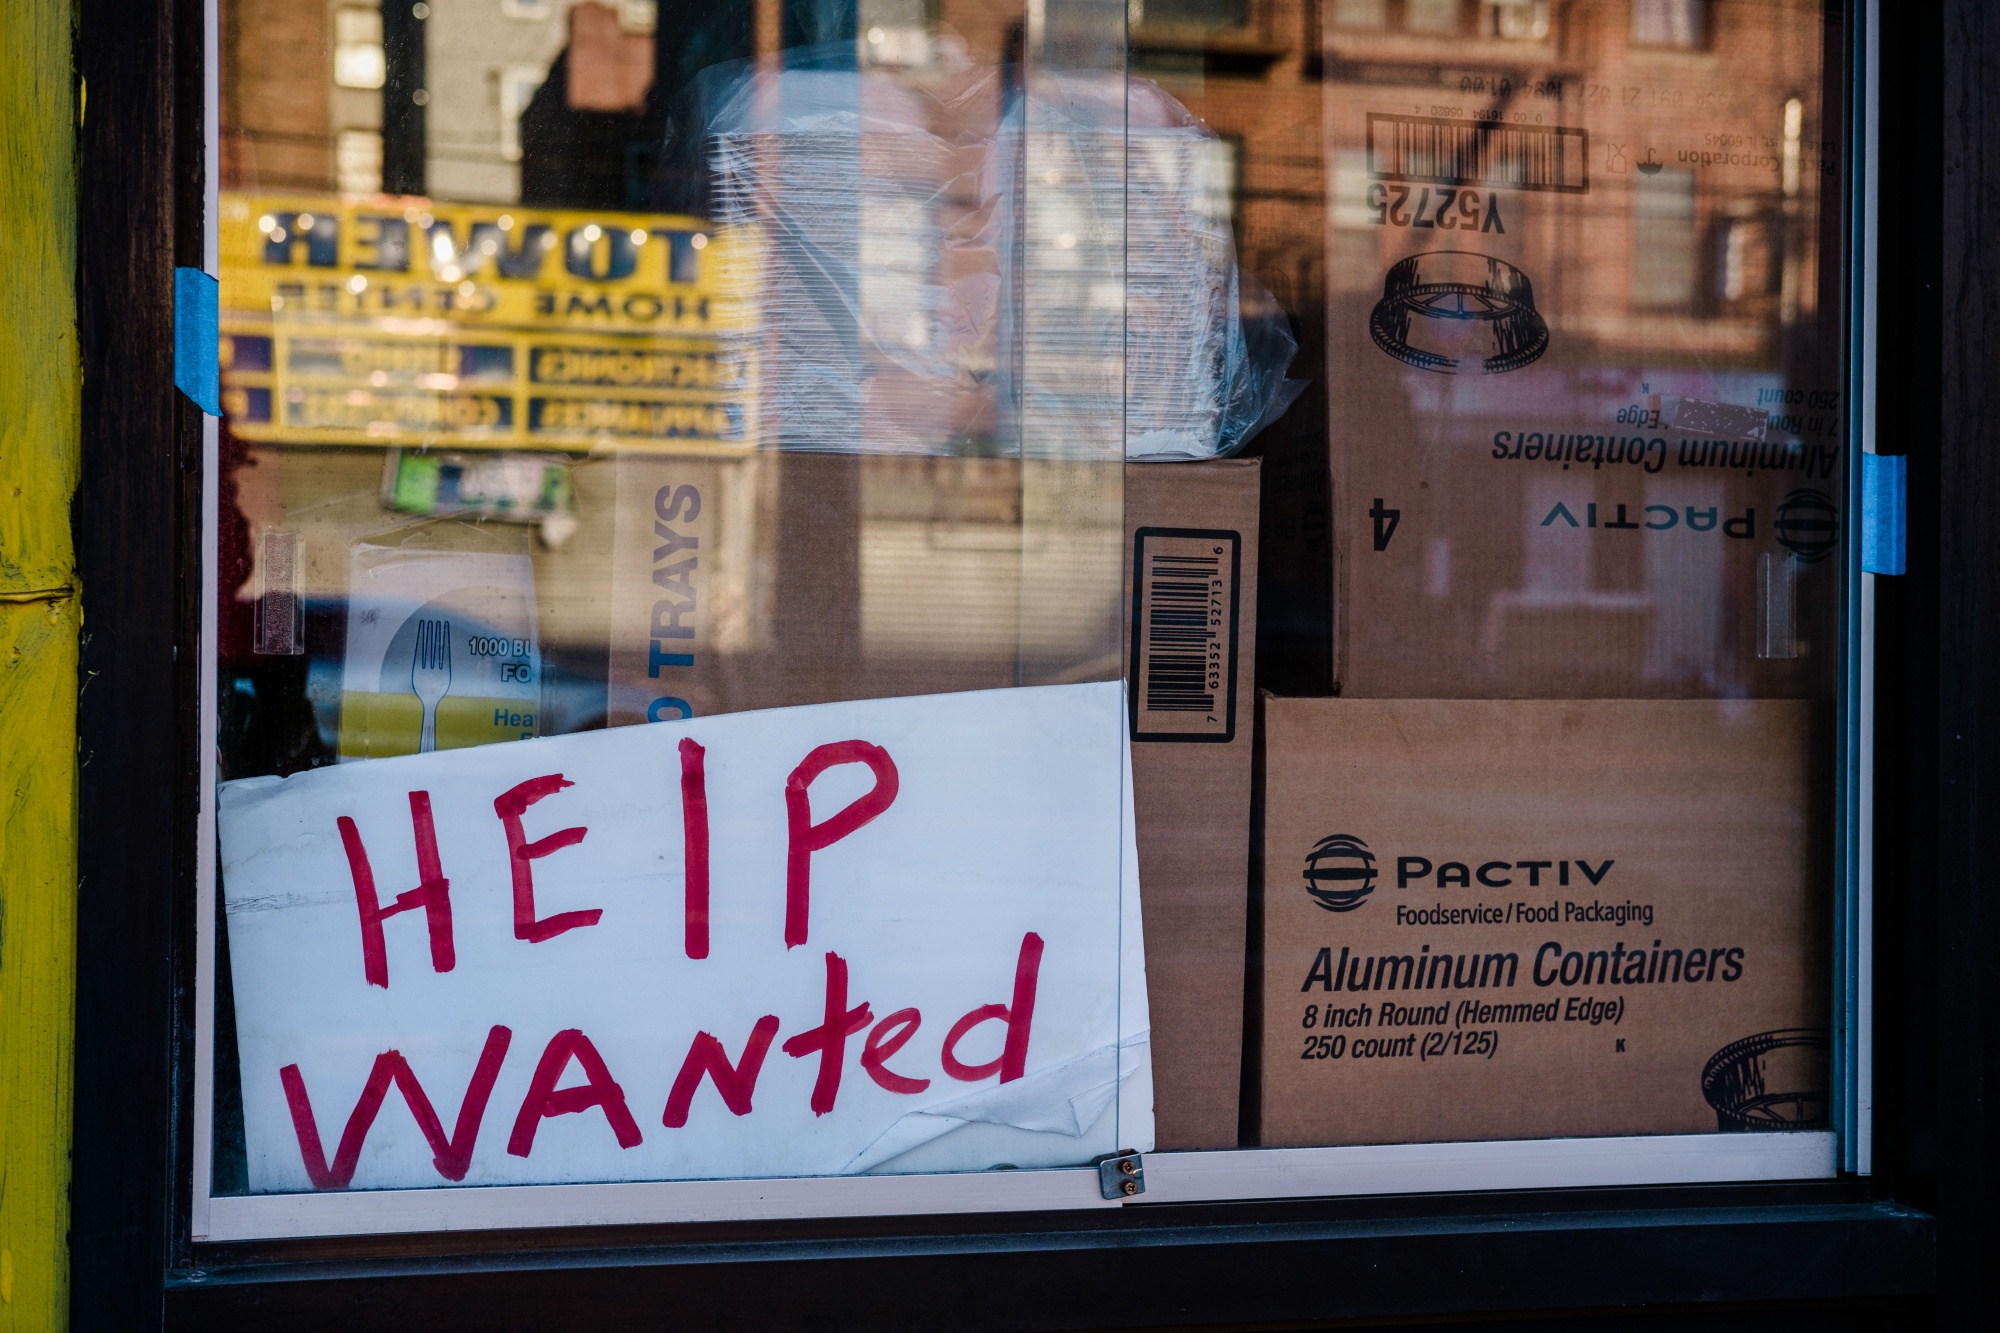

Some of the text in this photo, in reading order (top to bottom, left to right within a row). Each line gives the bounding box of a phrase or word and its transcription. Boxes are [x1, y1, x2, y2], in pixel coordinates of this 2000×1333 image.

[1430, 105, 1464, 118] 05620
[1472, 109, 1504, 121] 16194
[1677, 150, 1781, 172] Corporation
[1366, 183, 1506, 234] Y52725
[1757, 388, 1839, 410] 250 count
[1616, 405, 1660, 430] Edge
[1767, 415, 1802, 434] Rou
[1808, 416, 1824, 435] in
[1491, 431, 1840, 479] Aluminum Containers
[1369, 498, 1401, 551] 4
[648, 484, 702, 679] TRAYS
[469, 636, 509, 656] 1000
[1206, 546, 1224, 723] 7 63352 52713 6
[501, 663, 532, 683] FO
[494, 708, 537, 727] Hea
[1397, 856, 1616, 889] PACTIV
[1565, 899, 1654, 927] Packaging
[1301, 939, 1745, 993] Aluminum Containers
[1302, 995, 1625, 1030] 8 inch Round (Hemmed Edge)
[1301, 1030, 1499, 1062] 250 count (2/125)
[1615, 1038, 1627, 1054] K
